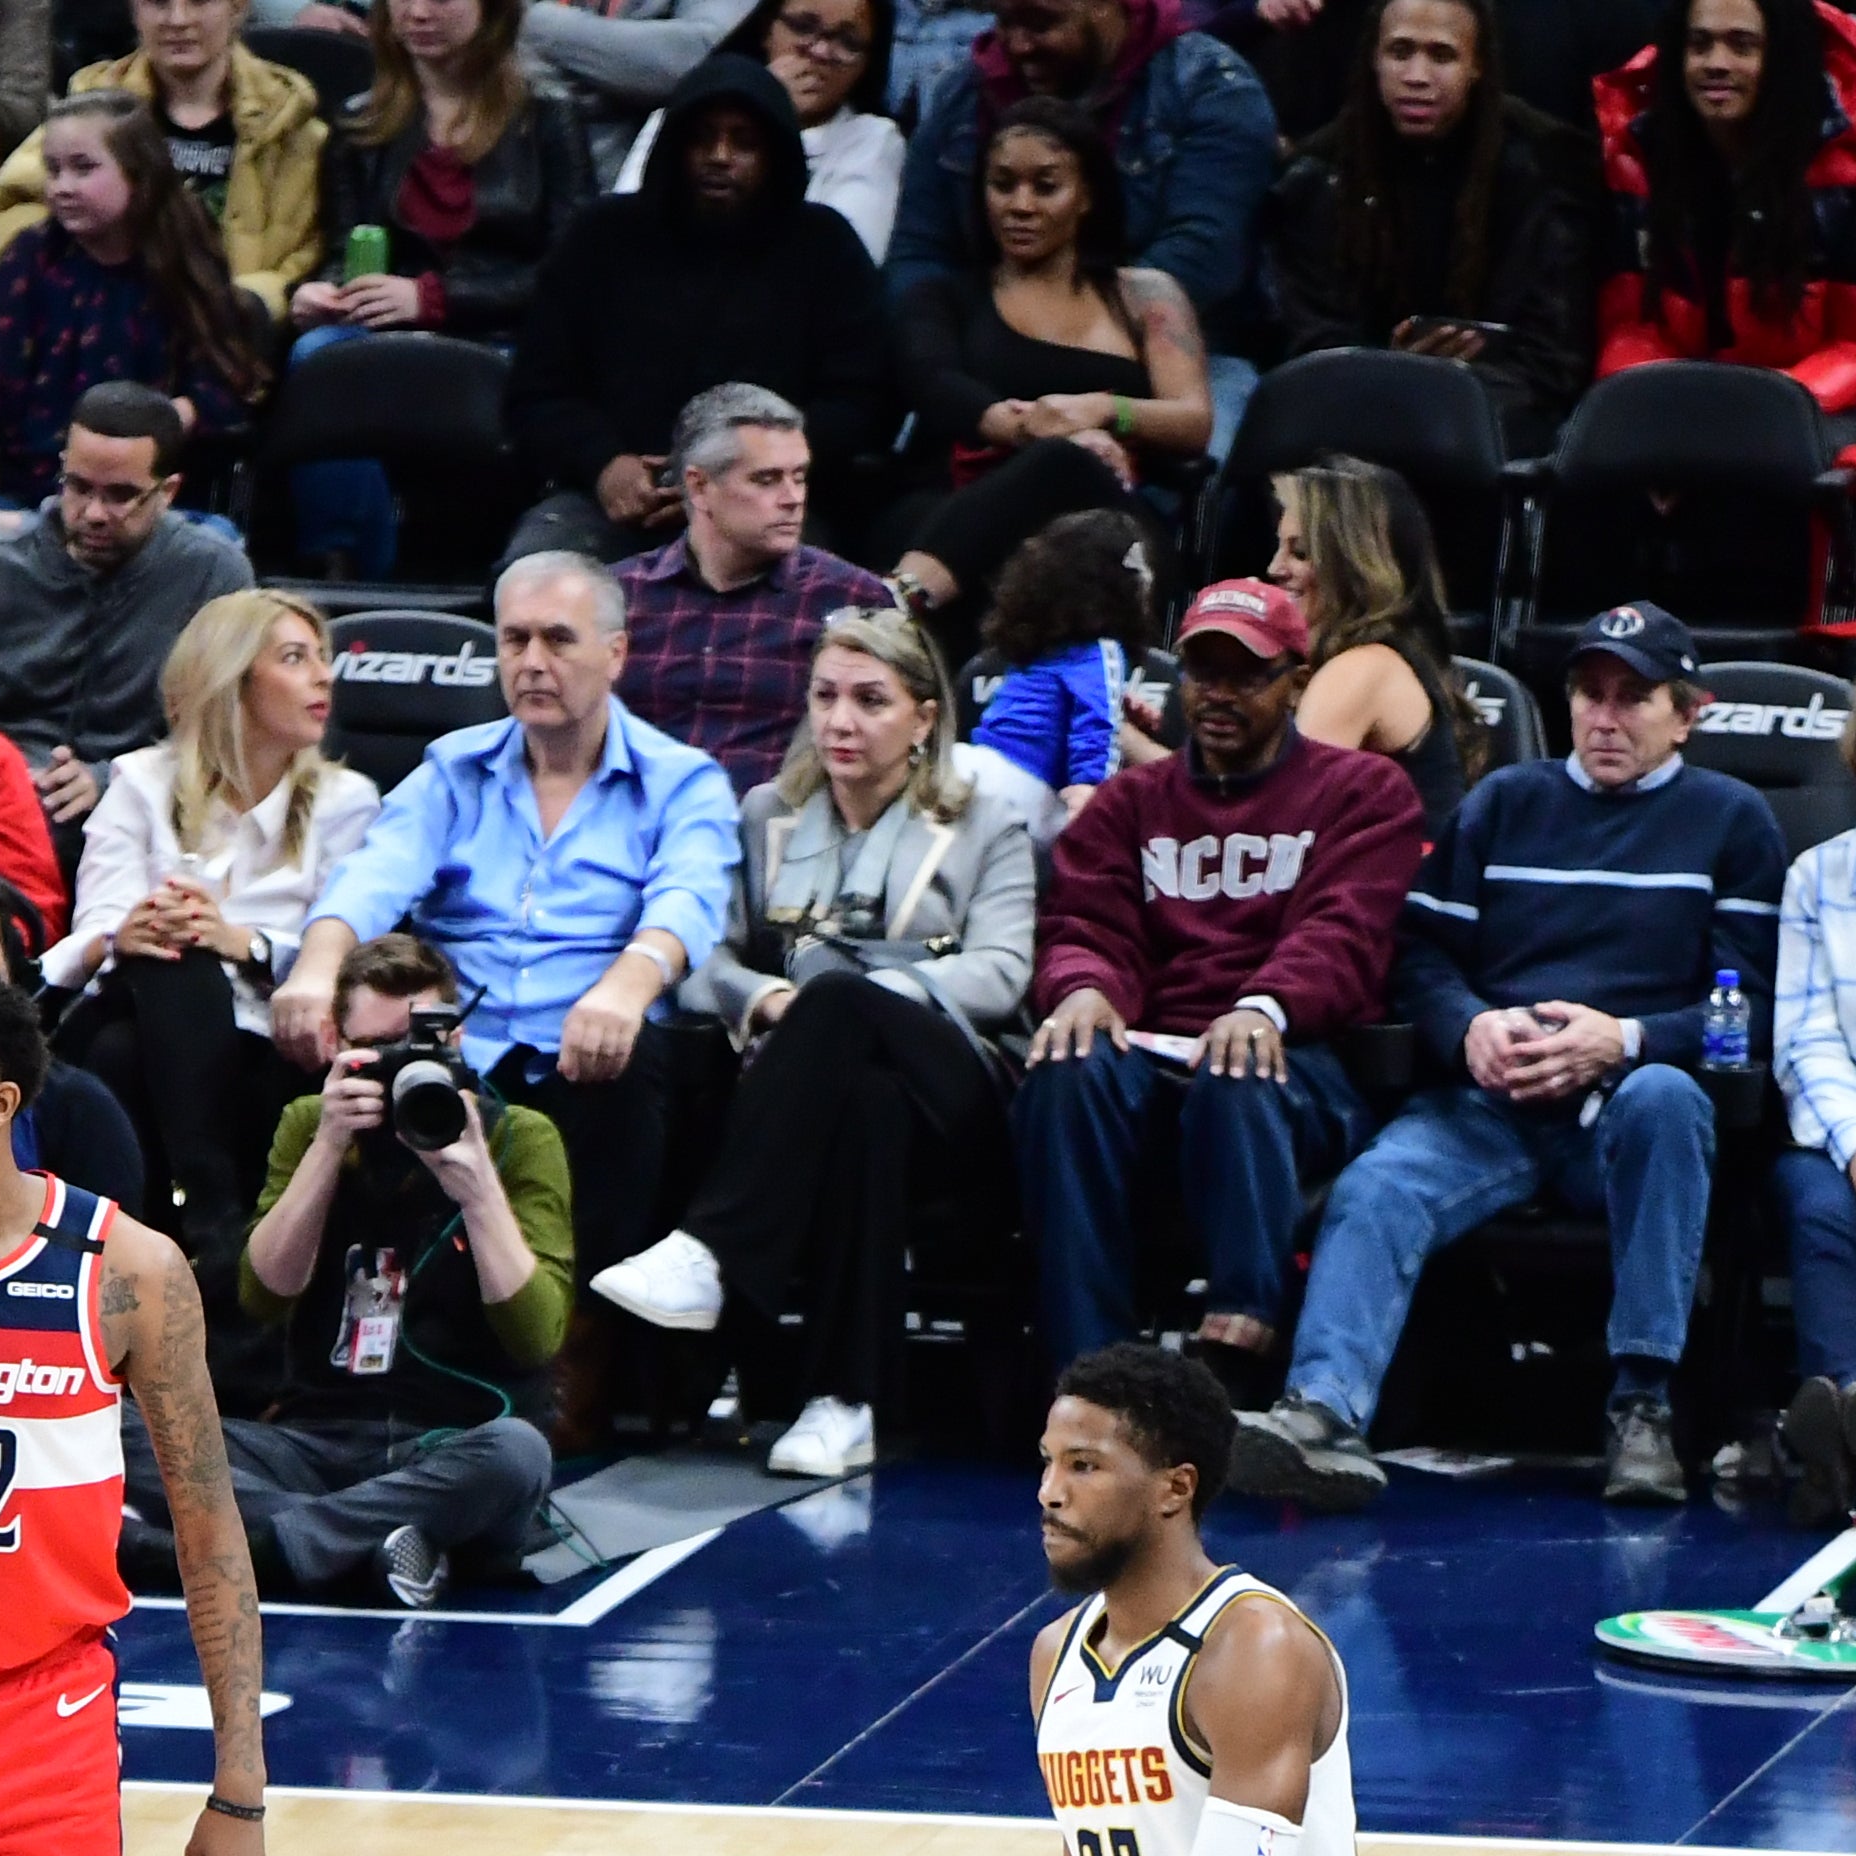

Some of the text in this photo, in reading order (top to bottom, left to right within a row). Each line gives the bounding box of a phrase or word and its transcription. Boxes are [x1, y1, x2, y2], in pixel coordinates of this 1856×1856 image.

[1696, 692, 1850, 740] zards
[7, 1281, 75, 1299] GEICO
[1139, 1665, 1173, 1686] WU
